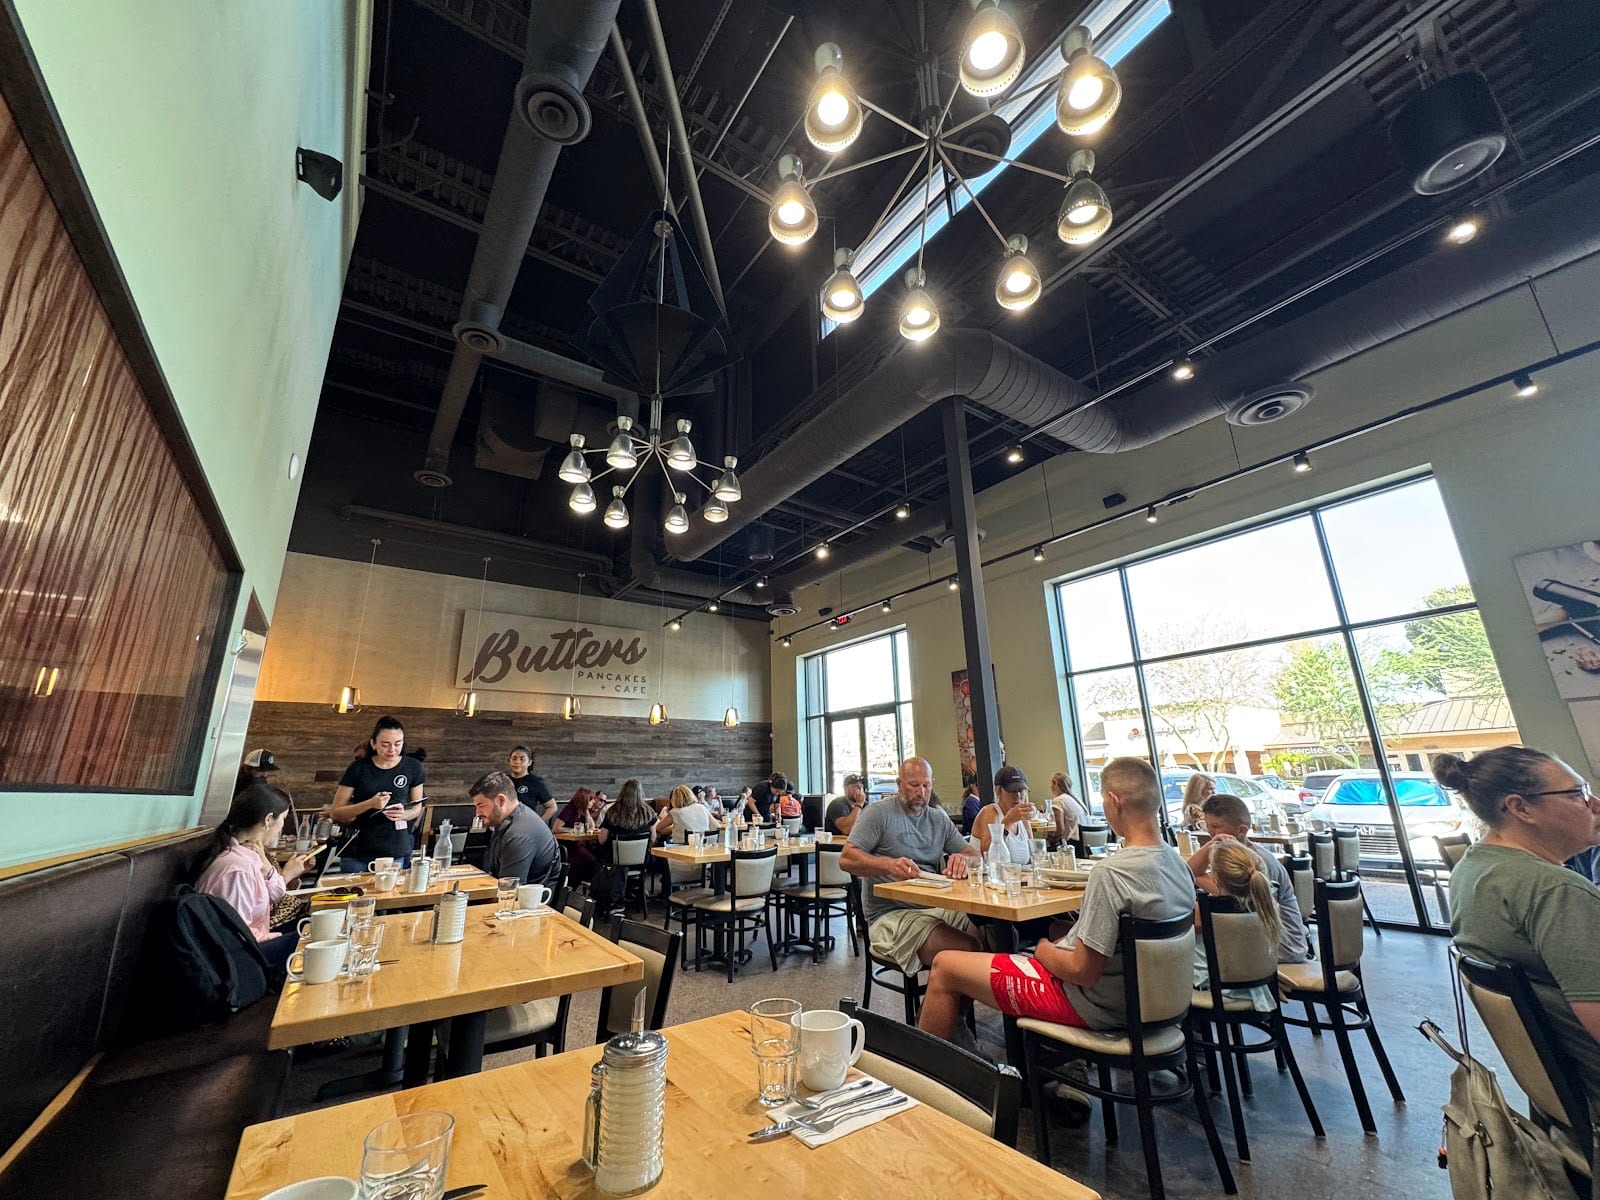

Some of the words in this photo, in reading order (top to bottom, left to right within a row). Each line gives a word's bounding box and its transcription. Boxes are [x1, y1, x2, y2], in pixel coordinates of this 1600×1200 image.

[462, 627, 648, 684] Butters
[577, 671, 647, 683] PANCAKES
[614, 684, 647, 694] CAFE
